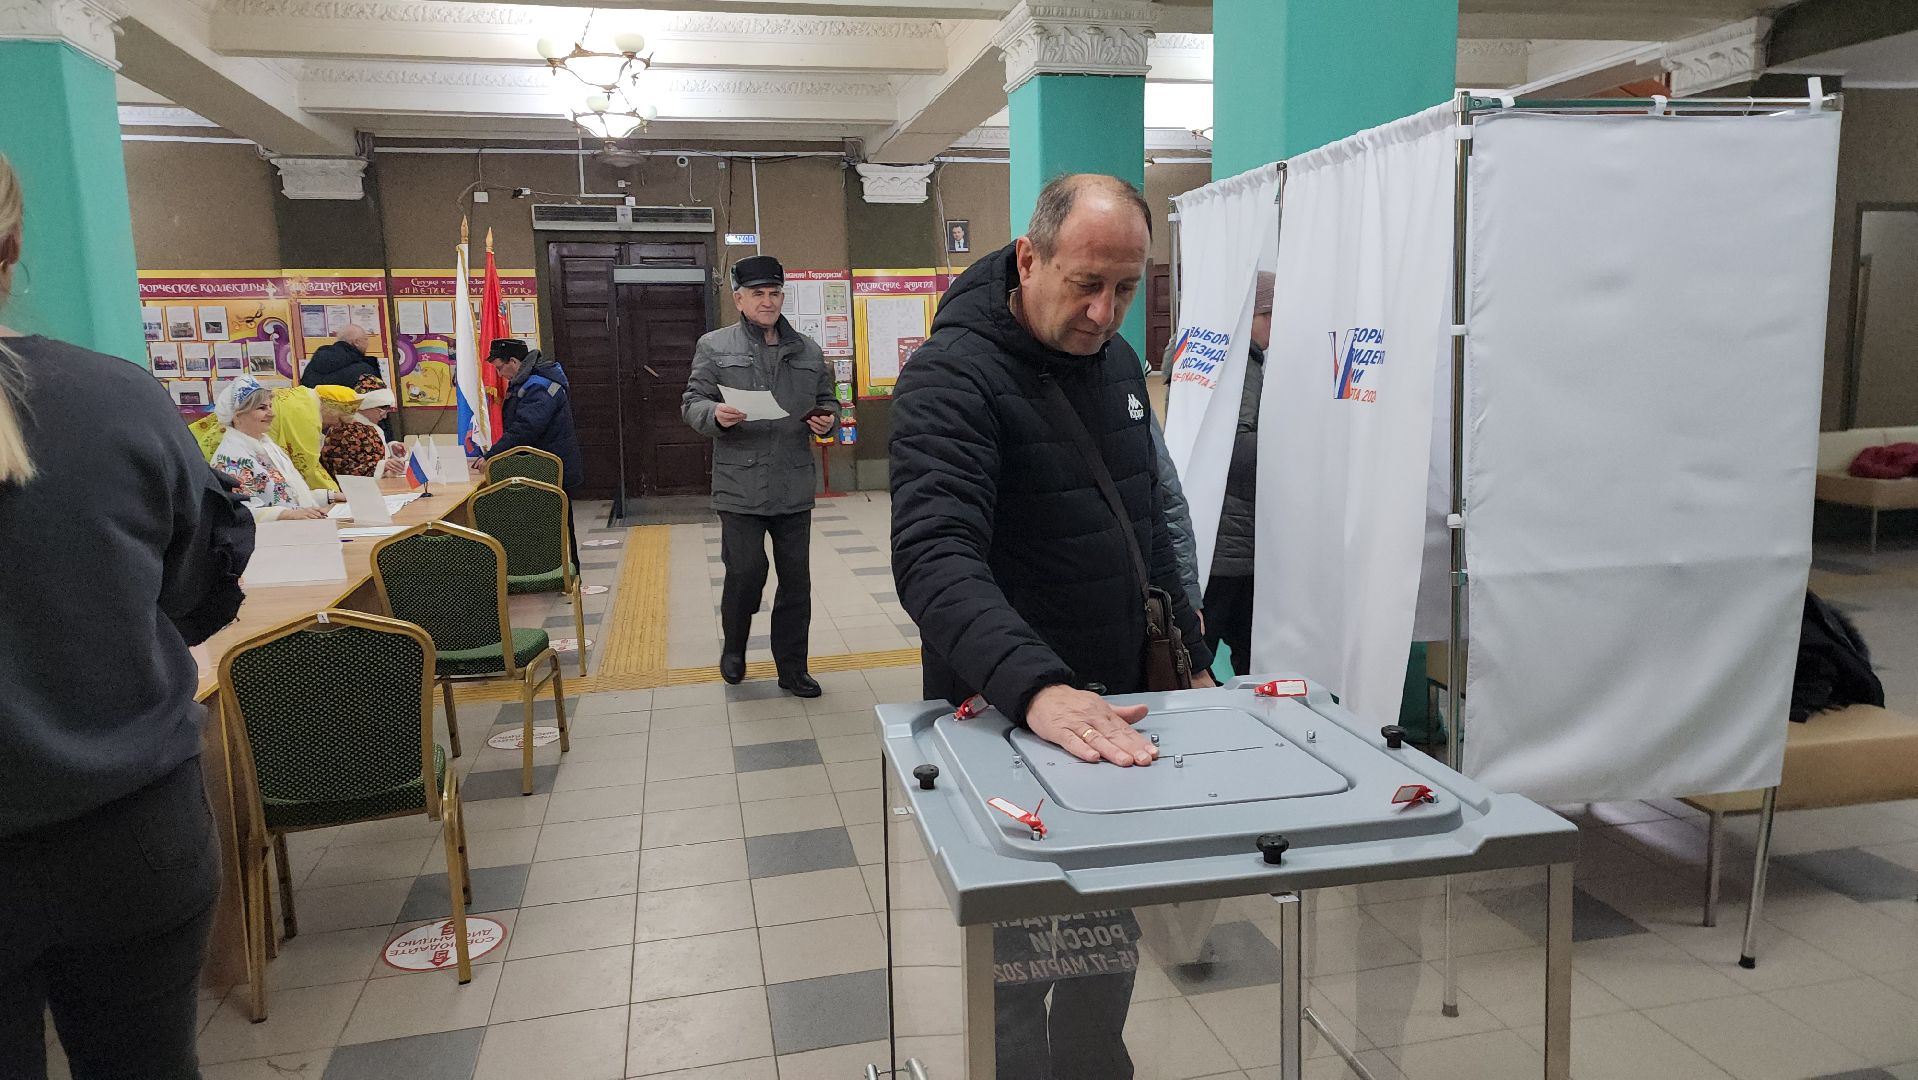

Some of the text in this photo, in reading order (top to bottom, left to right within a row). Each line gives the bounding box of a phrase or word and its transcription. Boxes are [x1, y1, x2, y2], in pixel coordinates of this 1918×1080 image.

[139, 282, 266, 294] ВОРЧЕСКИЕ КОЛЛЕКТИВЫ
[388, 936, 496, 957] СОБЮДАЙТЕ
[397, 927, 493, 948] ДИСАНЦИЮ
